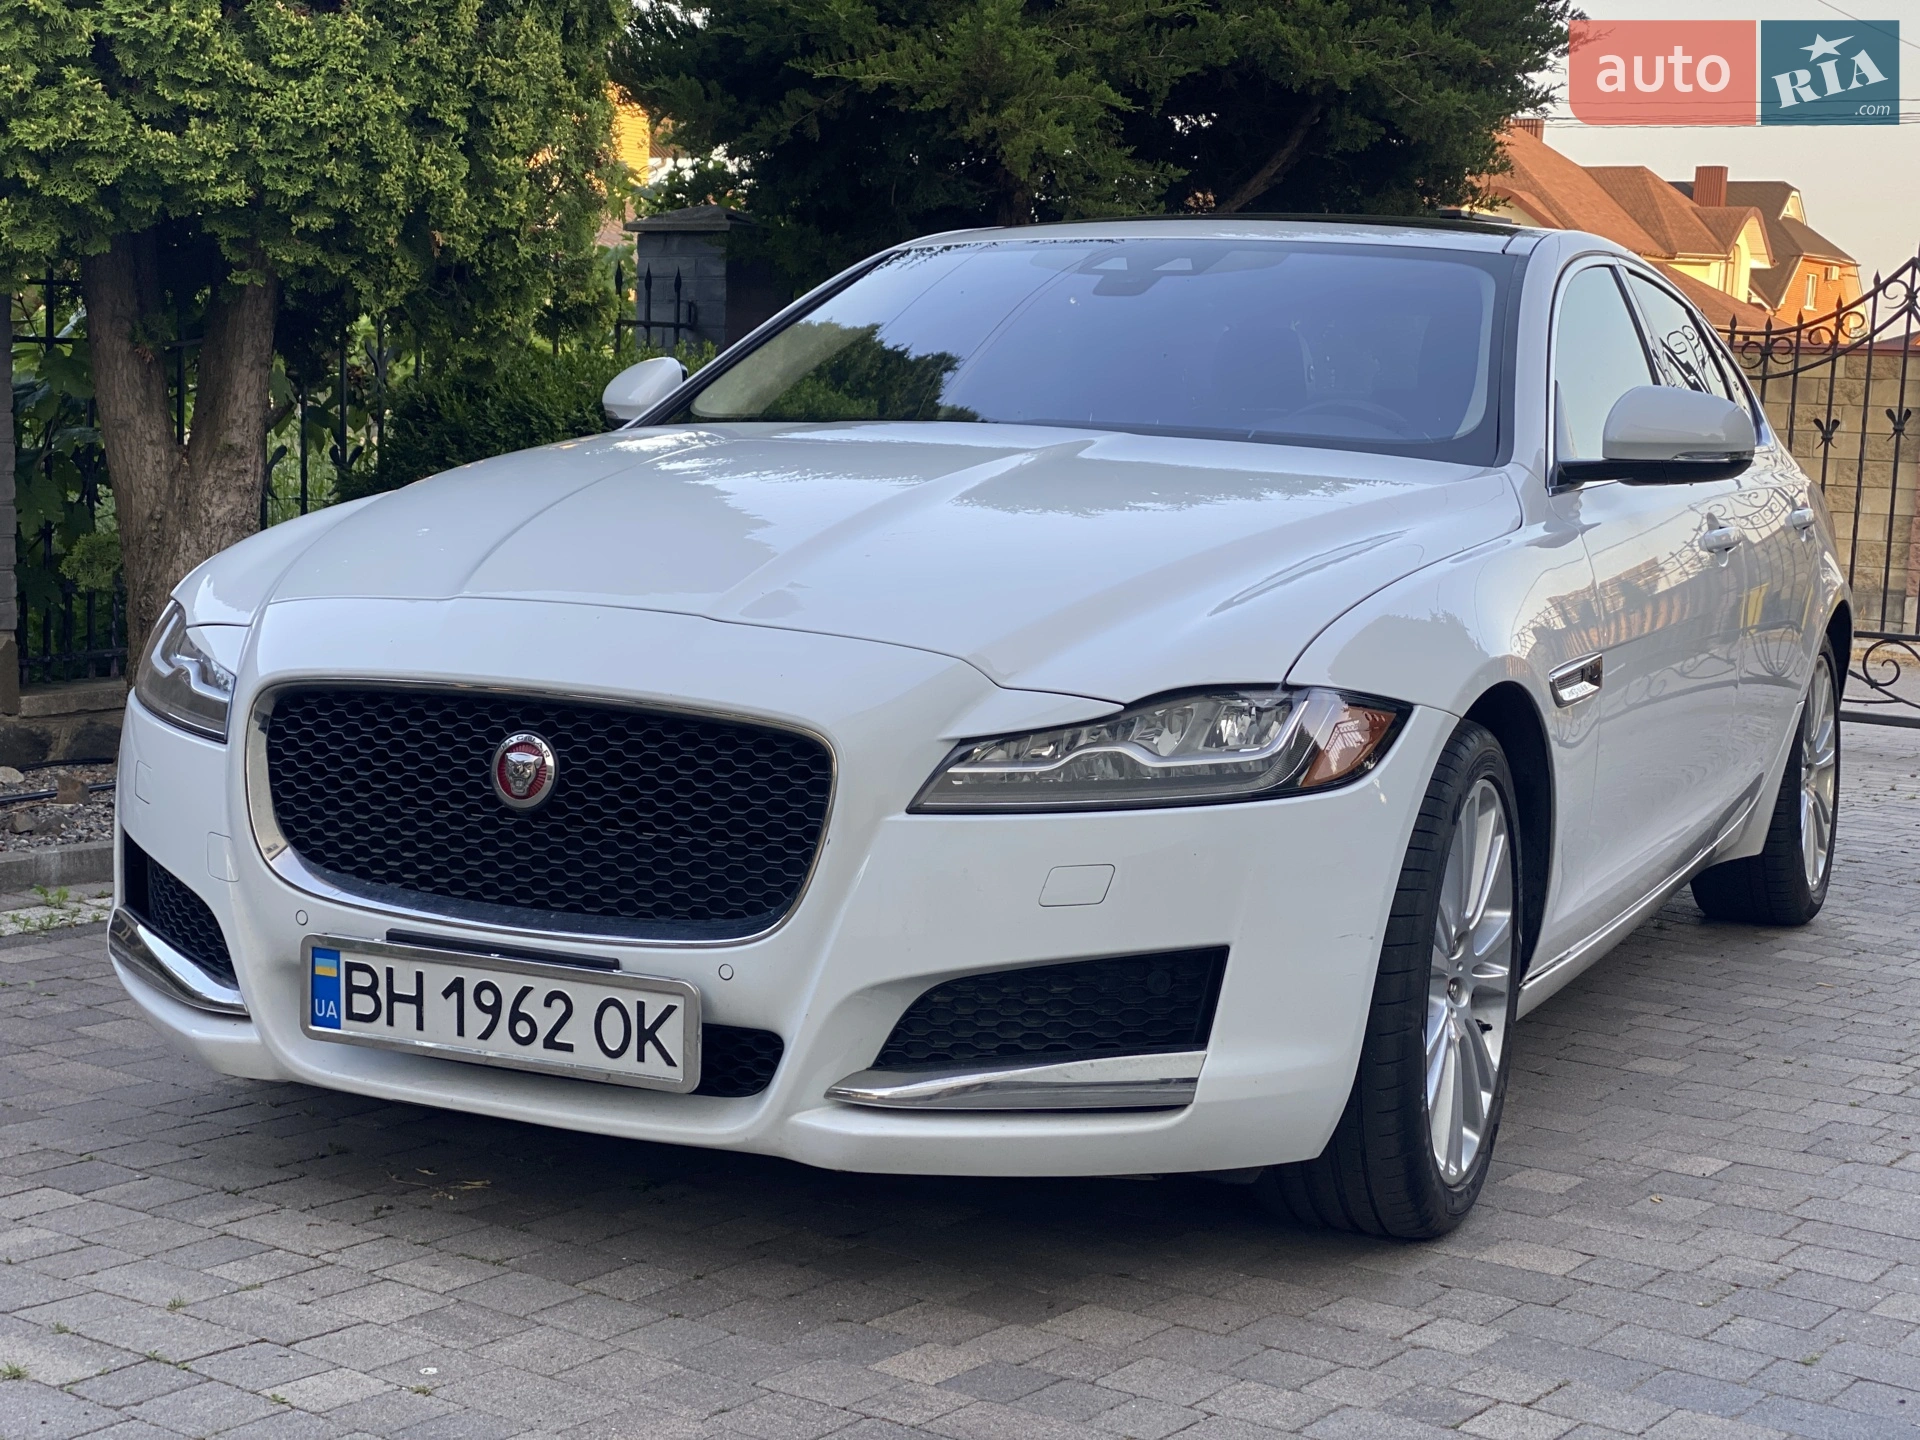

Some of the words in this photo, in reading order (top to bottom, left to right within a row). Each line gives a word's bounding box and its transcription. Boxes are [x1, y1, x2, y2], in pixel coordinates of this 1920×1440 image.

[501, 736, 551, 758] JAGUAR
[315, 998, 338, 1019] UA
[344, 961, 425, 1031] BH
[441, 977, 575, 1052] 1962
[594, 998, 678, 1068] OK
